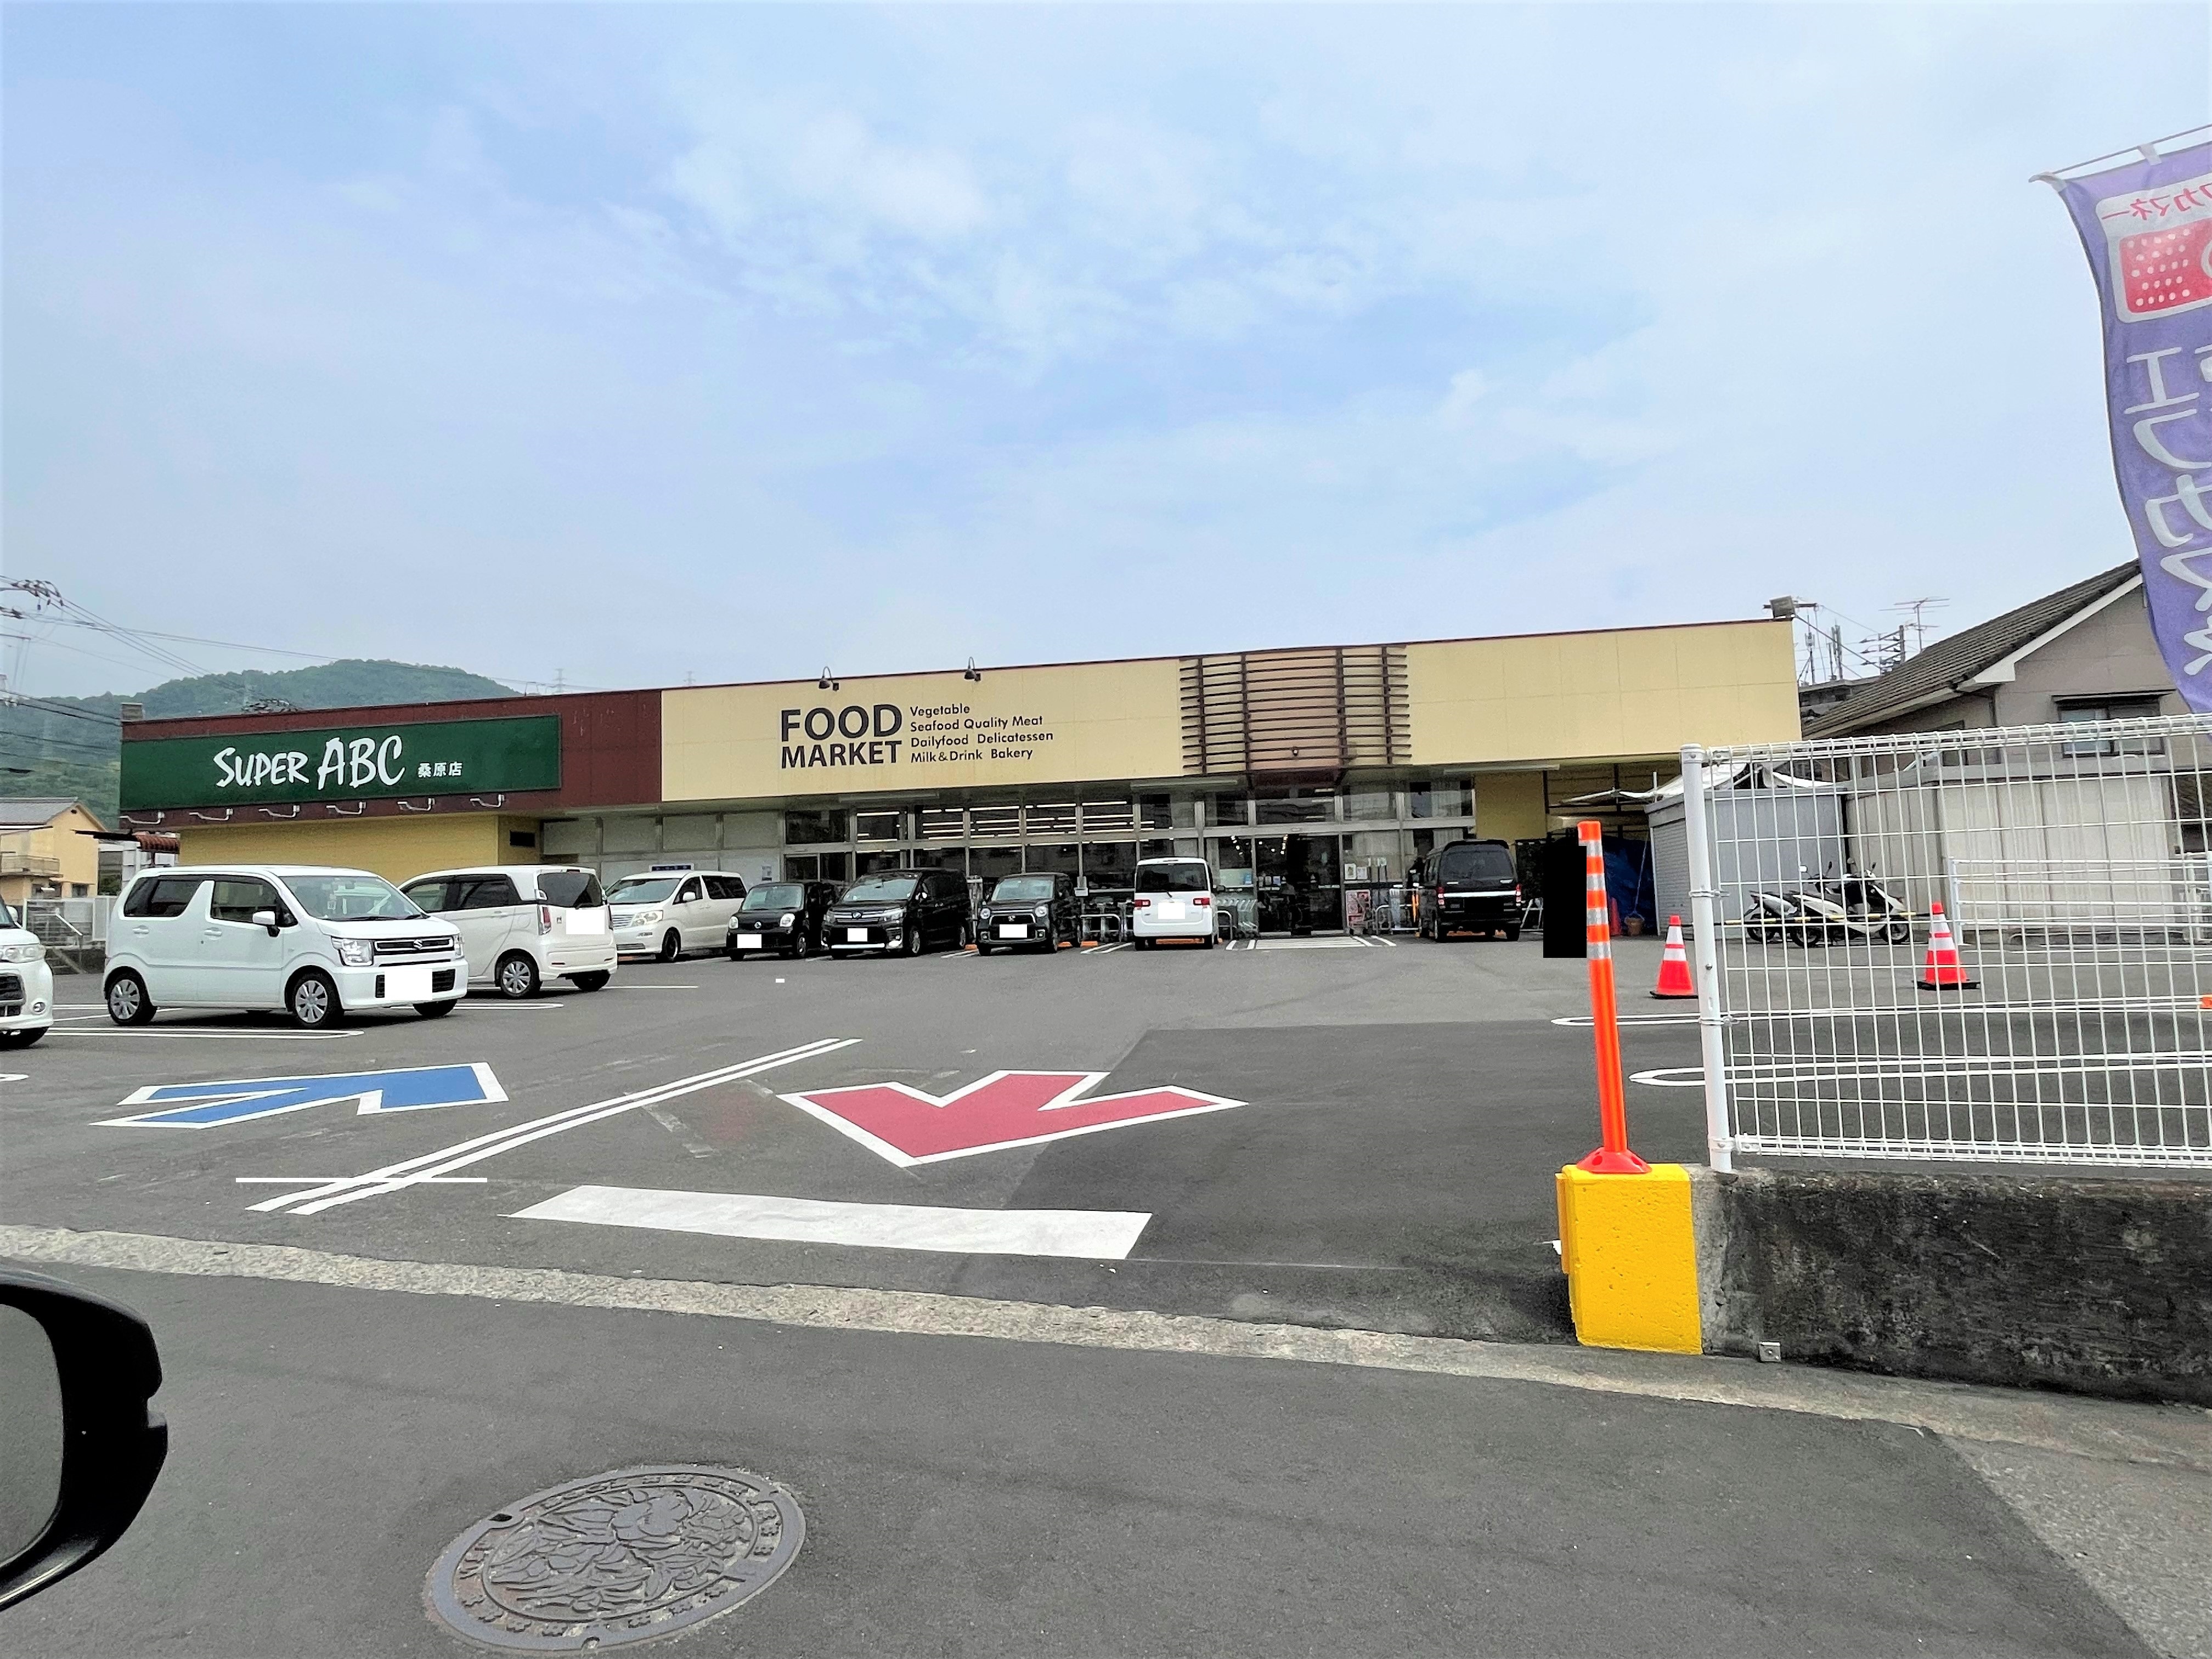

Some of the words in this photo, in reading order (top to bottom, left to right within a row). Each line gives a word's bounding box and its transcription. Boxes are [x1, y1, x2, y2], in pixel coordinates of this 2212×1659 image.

[910, 703, 970, 718] Vegetable
[781, 704, 902, 741] FOOD
[911, 720, 959, 732] Seafood
[964, 717, 1008, 730] Quality
[1012, 716, 1043, 726] Meat
[911, 735, 968, 749] Dailyfood
[978, 732, 1053, 744] Delicatessen
[782, 741, 902, 769] MARKET
[991, 747, 1032, 760] Bakery
[213, 747, 309, 787] SUPER
[318, 735, 405, 789] ABC
[418, 762, 463, 778] 桑原店
